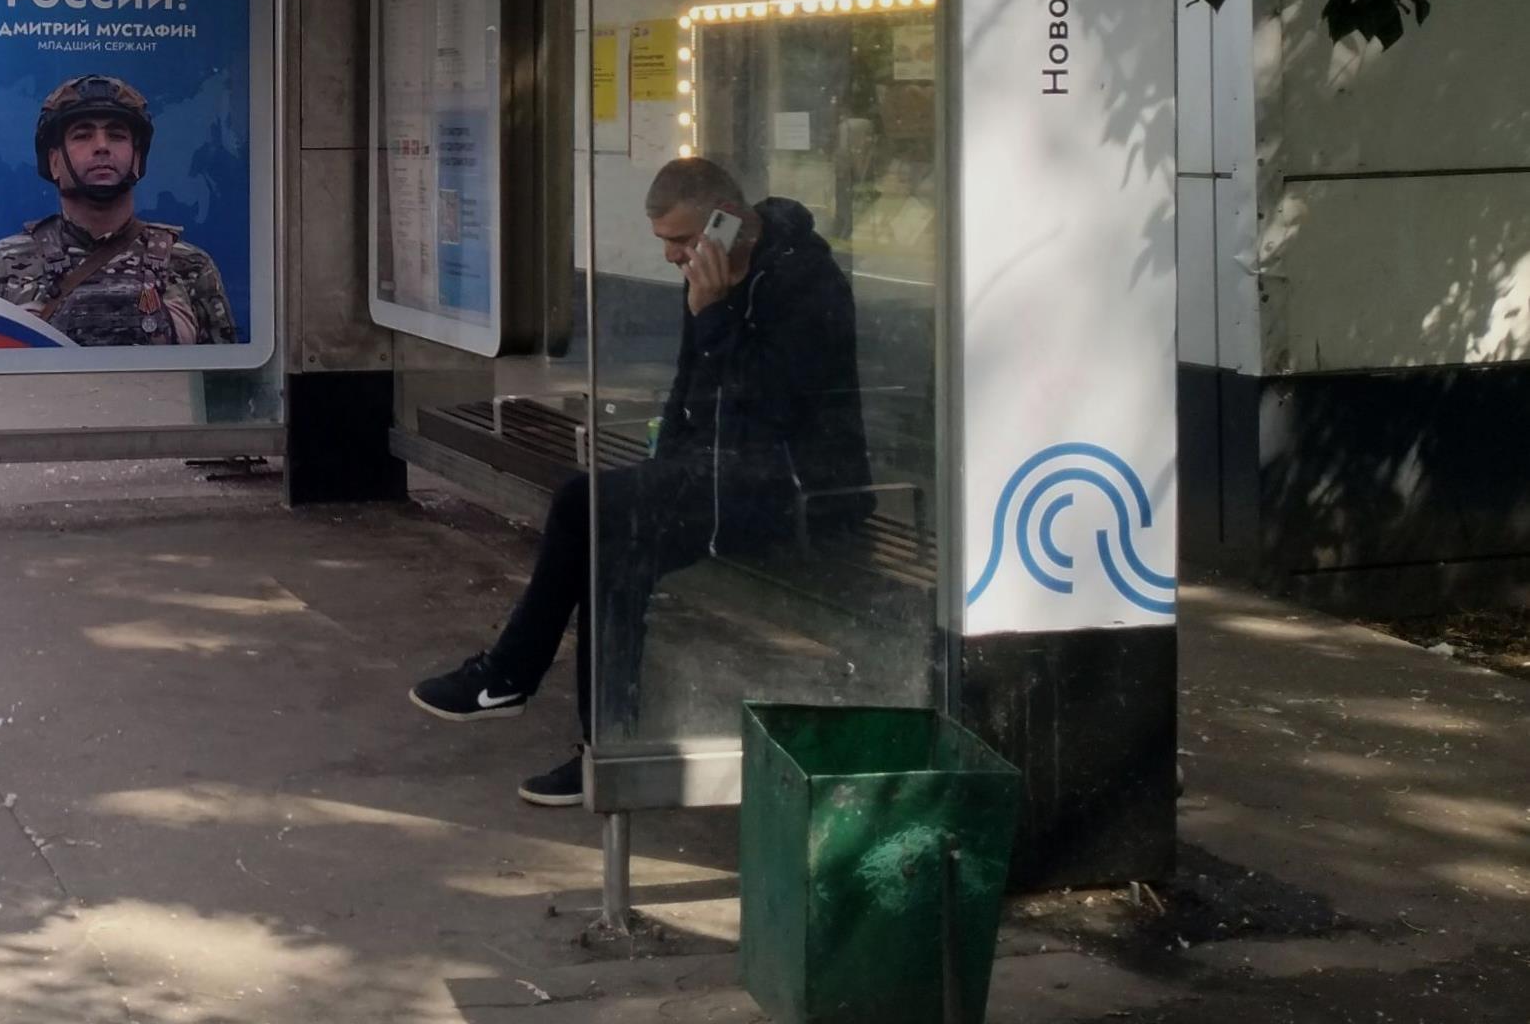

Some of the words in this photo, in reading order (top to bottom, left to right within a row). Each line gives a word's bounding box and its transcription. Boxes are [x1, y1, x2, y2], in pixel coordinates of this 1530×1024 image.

[96, 23, 197, 38] МУСТАФИН
[37, 40, 102, 52] МЛАДШИЙ
[104, 41, 158, 52] СЕРЖАНТ
